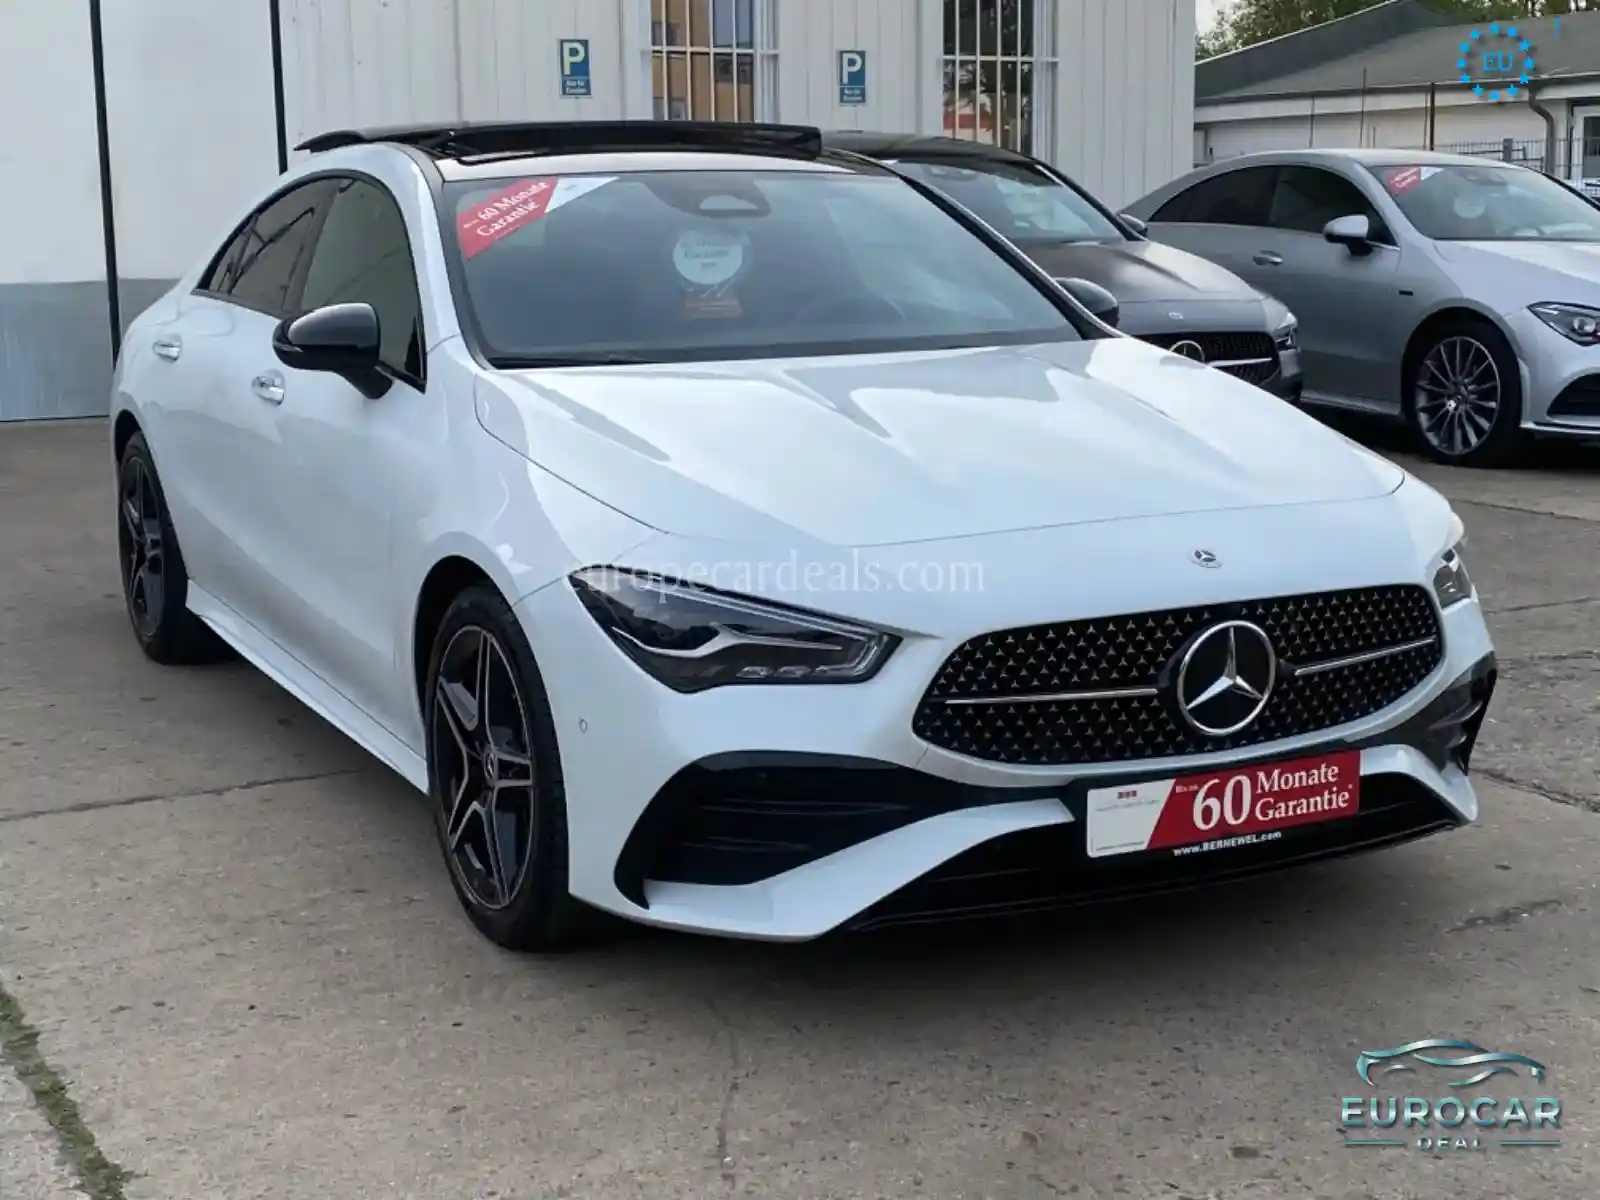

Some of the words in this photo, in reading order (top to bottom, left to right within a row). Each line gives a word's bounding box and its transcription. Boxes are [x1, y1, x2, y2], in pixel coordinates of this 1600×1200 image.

[563, 42, 585, 75] P
[842, 52, 862, 84] P
[477, 206, 499, 221] 60
[498, 181, 549, 214] Monate
[1193, 775, 1251, 831] 60
[1255, 762, 1339, 794] Monate
